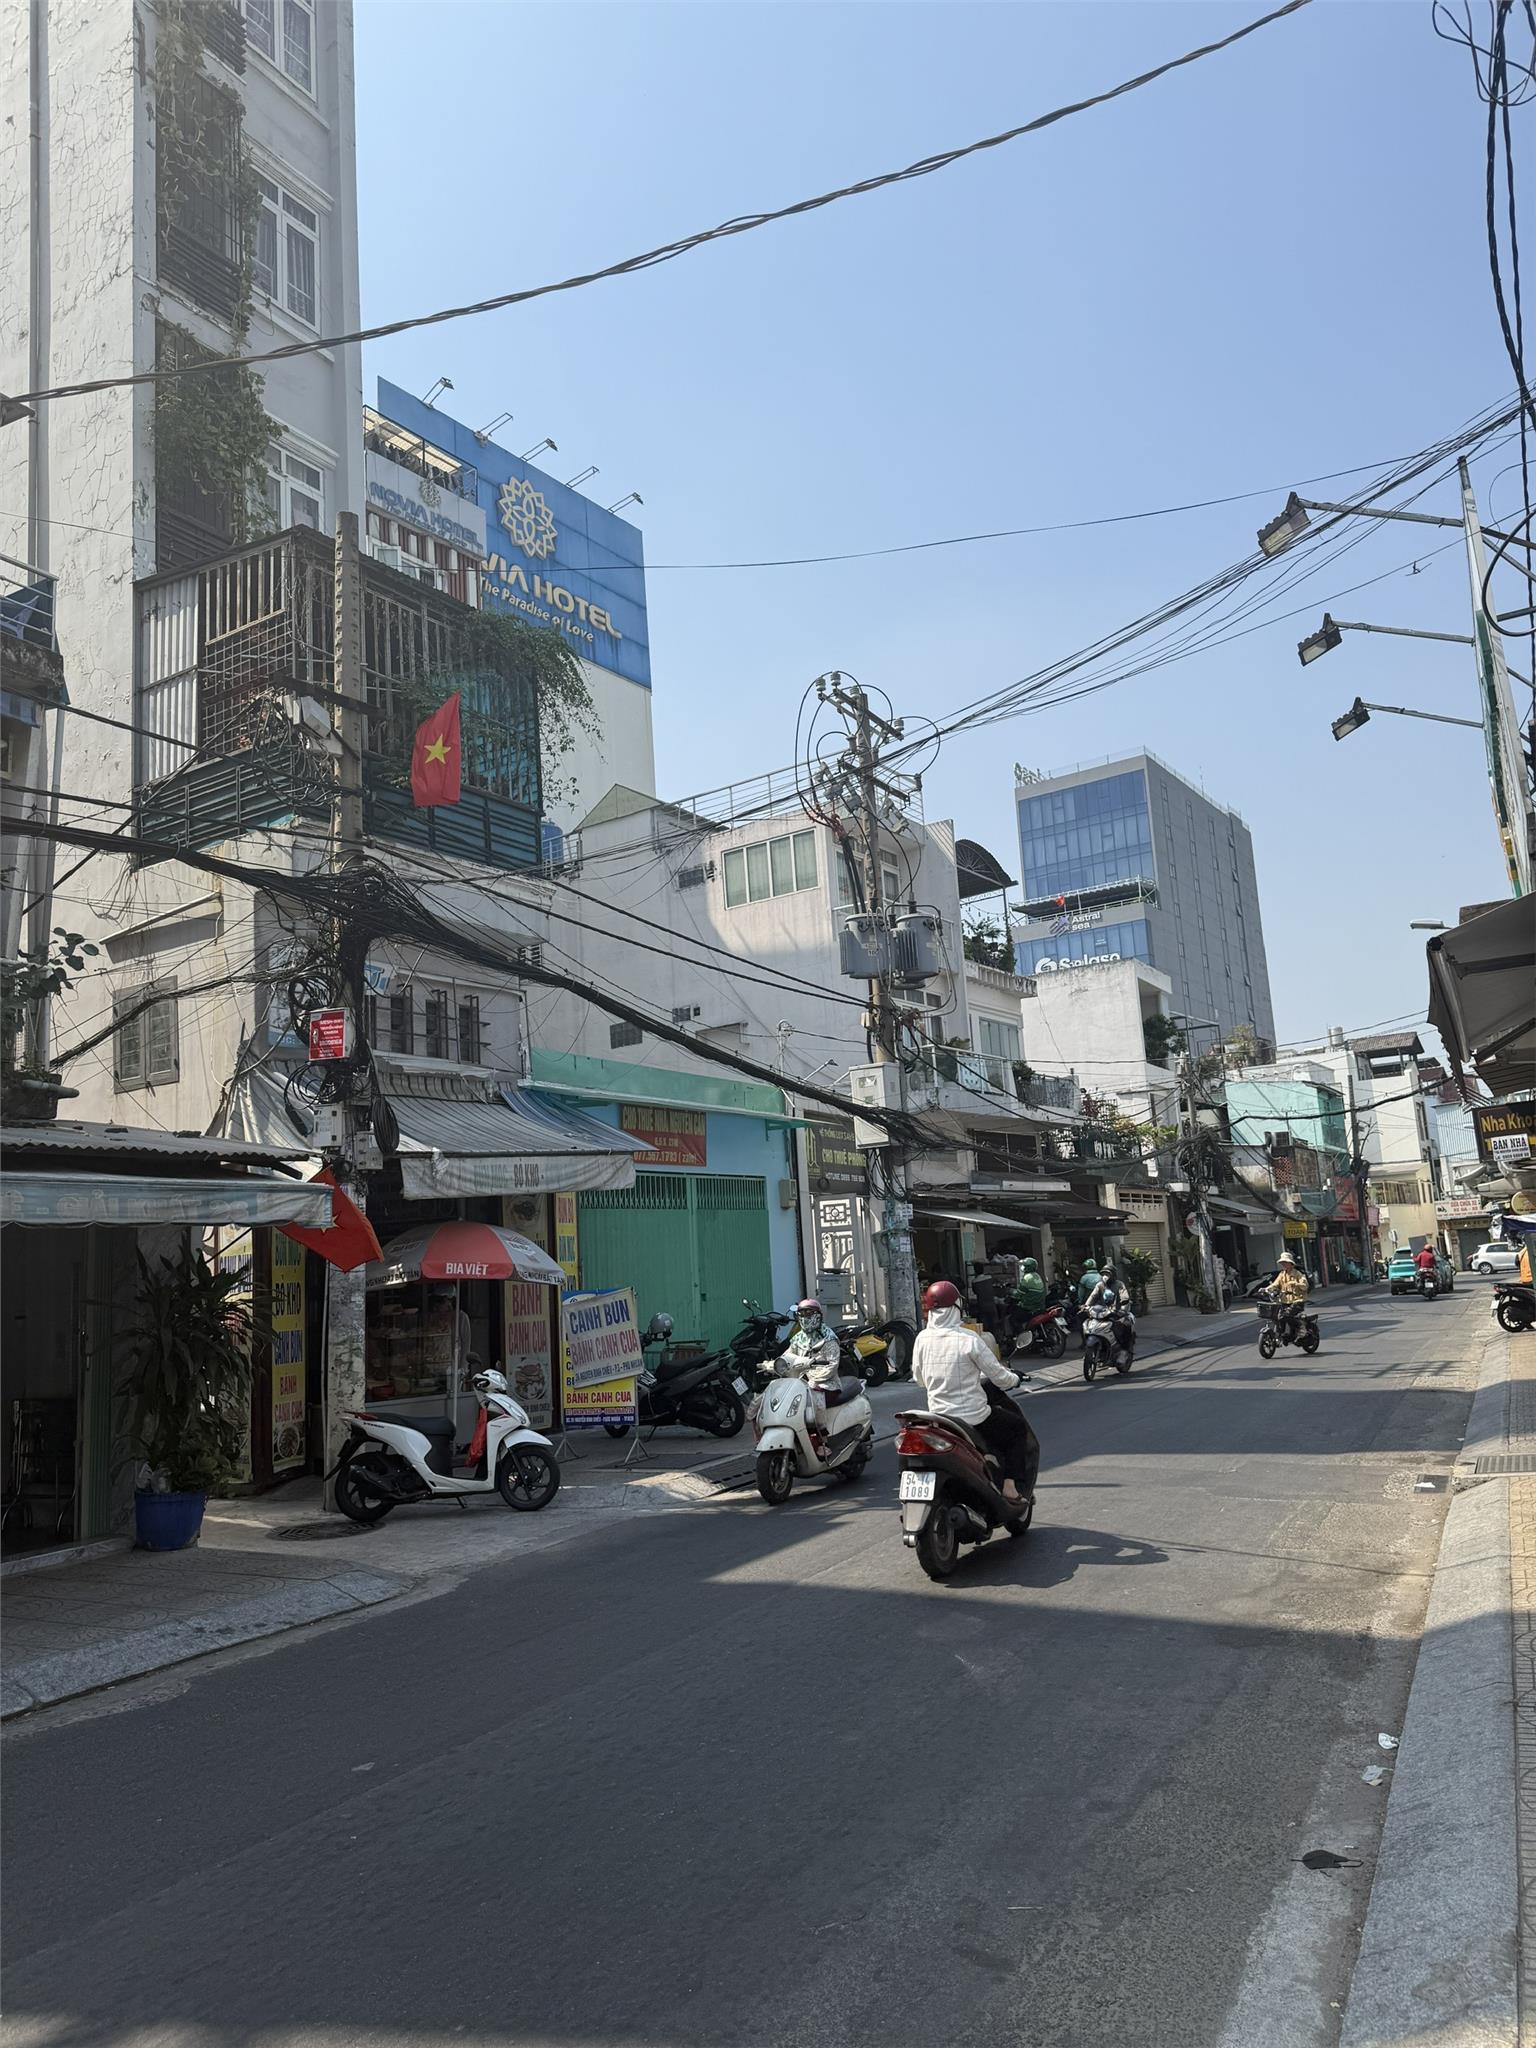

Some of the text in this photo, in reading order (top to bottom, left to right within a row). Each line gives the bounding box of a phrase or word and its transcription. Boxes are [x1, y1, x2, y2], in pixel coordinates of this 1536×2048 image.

[501, 588, 550, 621] Paradise
[566, 620, 594, 642] Love
[533, 574, 622, 639] HOTEL
[1072, 911, 1101, 924] Astral
[1072, 922, 1091, 931] sea
[1481, 1113, 1536, 1132] Nha Kho
[525, 1163, 539, 1187] KHO
[446, 1261, 489, 1277] BIA VIỆT
[569, 1305, 602, 1334] CANH
[508, 1320, 548, 1356] CANH CUA
[595, 1333, 619, 1360] CANH
[619, 1329, 639, 1354] CUA
[566, 1390, 632, 1404] BÁNH CANH CUA
[906, 1486, 930, 1498] 1089
